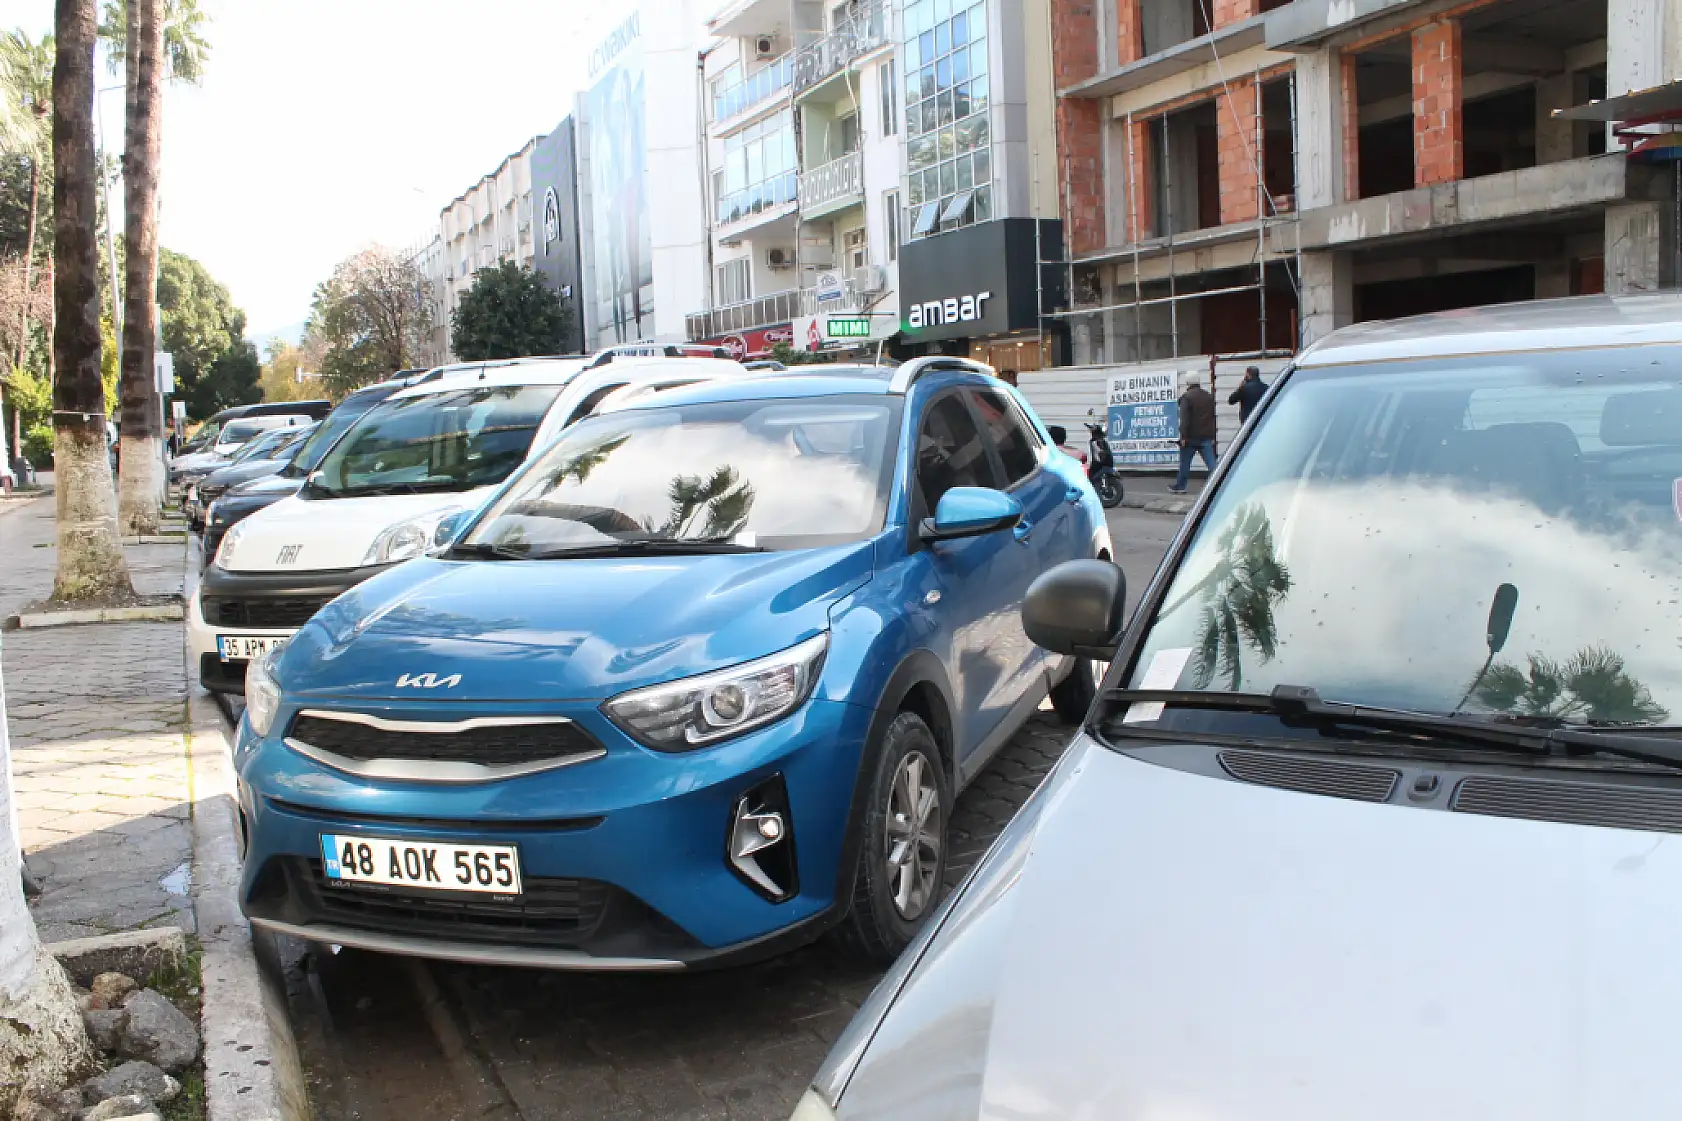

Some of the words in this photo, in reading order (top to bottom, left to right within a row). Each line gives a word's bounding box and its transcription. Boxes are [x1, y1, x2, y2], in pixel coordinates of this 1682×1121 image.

[1114, 380, 1127, 391] BU
[276, 544, 304, 564] FIAT
[225, 638, 239, 656] 35
[341, 841, 374, 876] 48
[389, 846, 441, 882] AOK
[454, 850, 513, 887] 565
